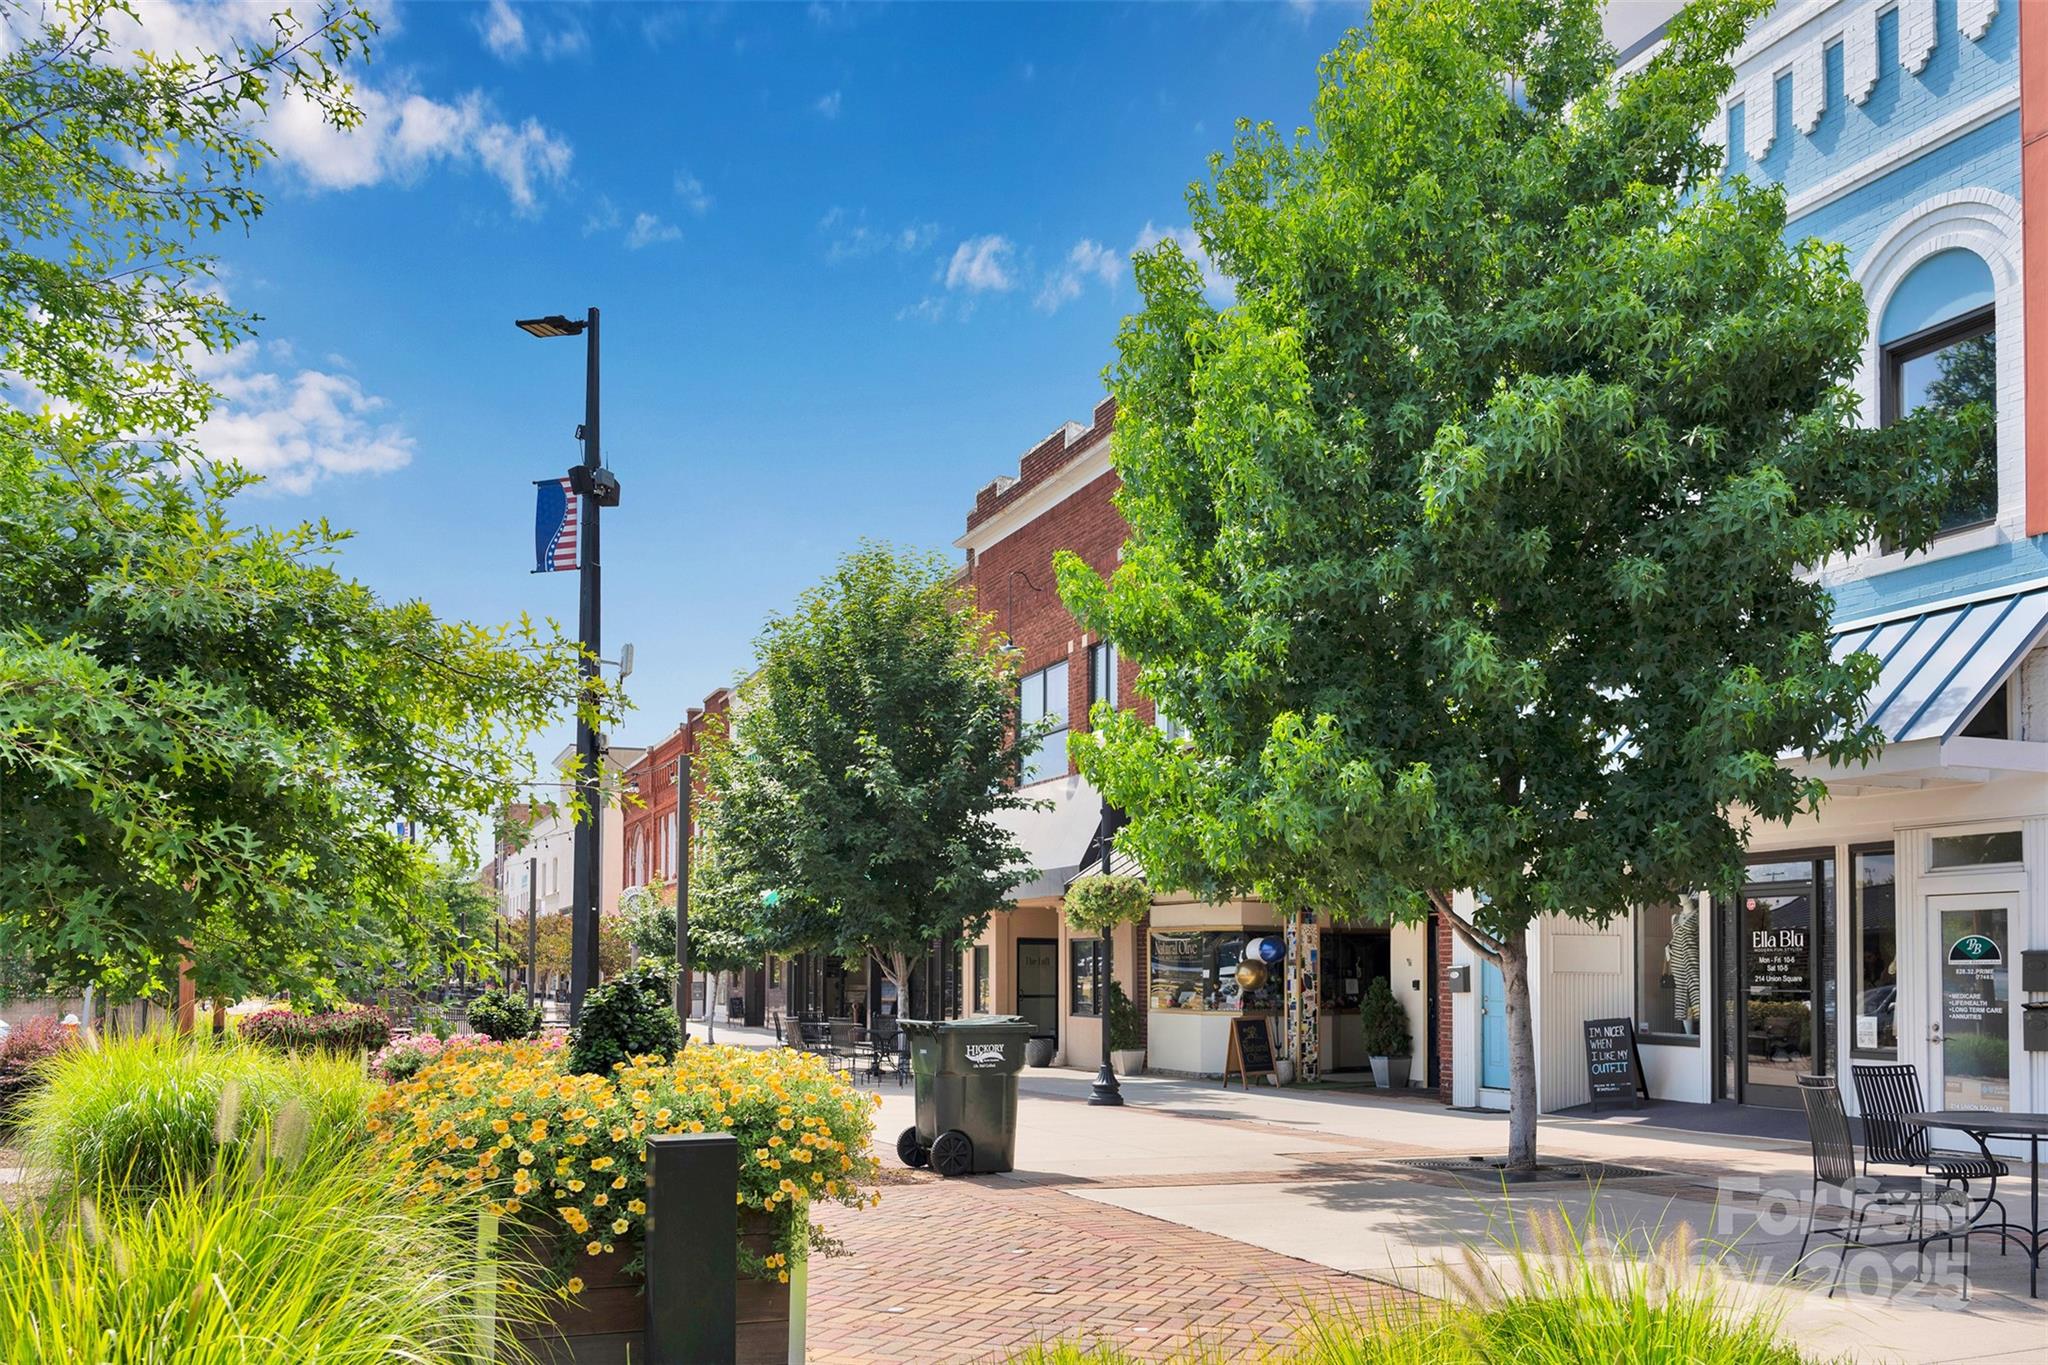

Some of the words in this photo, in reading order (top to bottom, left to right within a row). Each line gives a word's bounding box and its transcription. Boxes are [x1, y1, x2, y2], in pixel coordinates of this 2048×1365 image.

[1752, 930, 1777, 948] Ella
[1780, 930, 1804, 947] Blu
[1154, 940, 1177, 956] Natural
[1178, 939, 1198, 956] Olive
[1782, 975, 1803, 984] Square
[1603, 1025, 1625, 1038] NICER
[966, 1044, 1004, 1057] HICKORY
[1589, 1039, 1612, 1050] WHEN
[1599, 1050, 1616, 1061] LIKE
[1617, 1049, 1629, 1060] MY
[1591, 1061, 1629, 1075] OUTFIT
